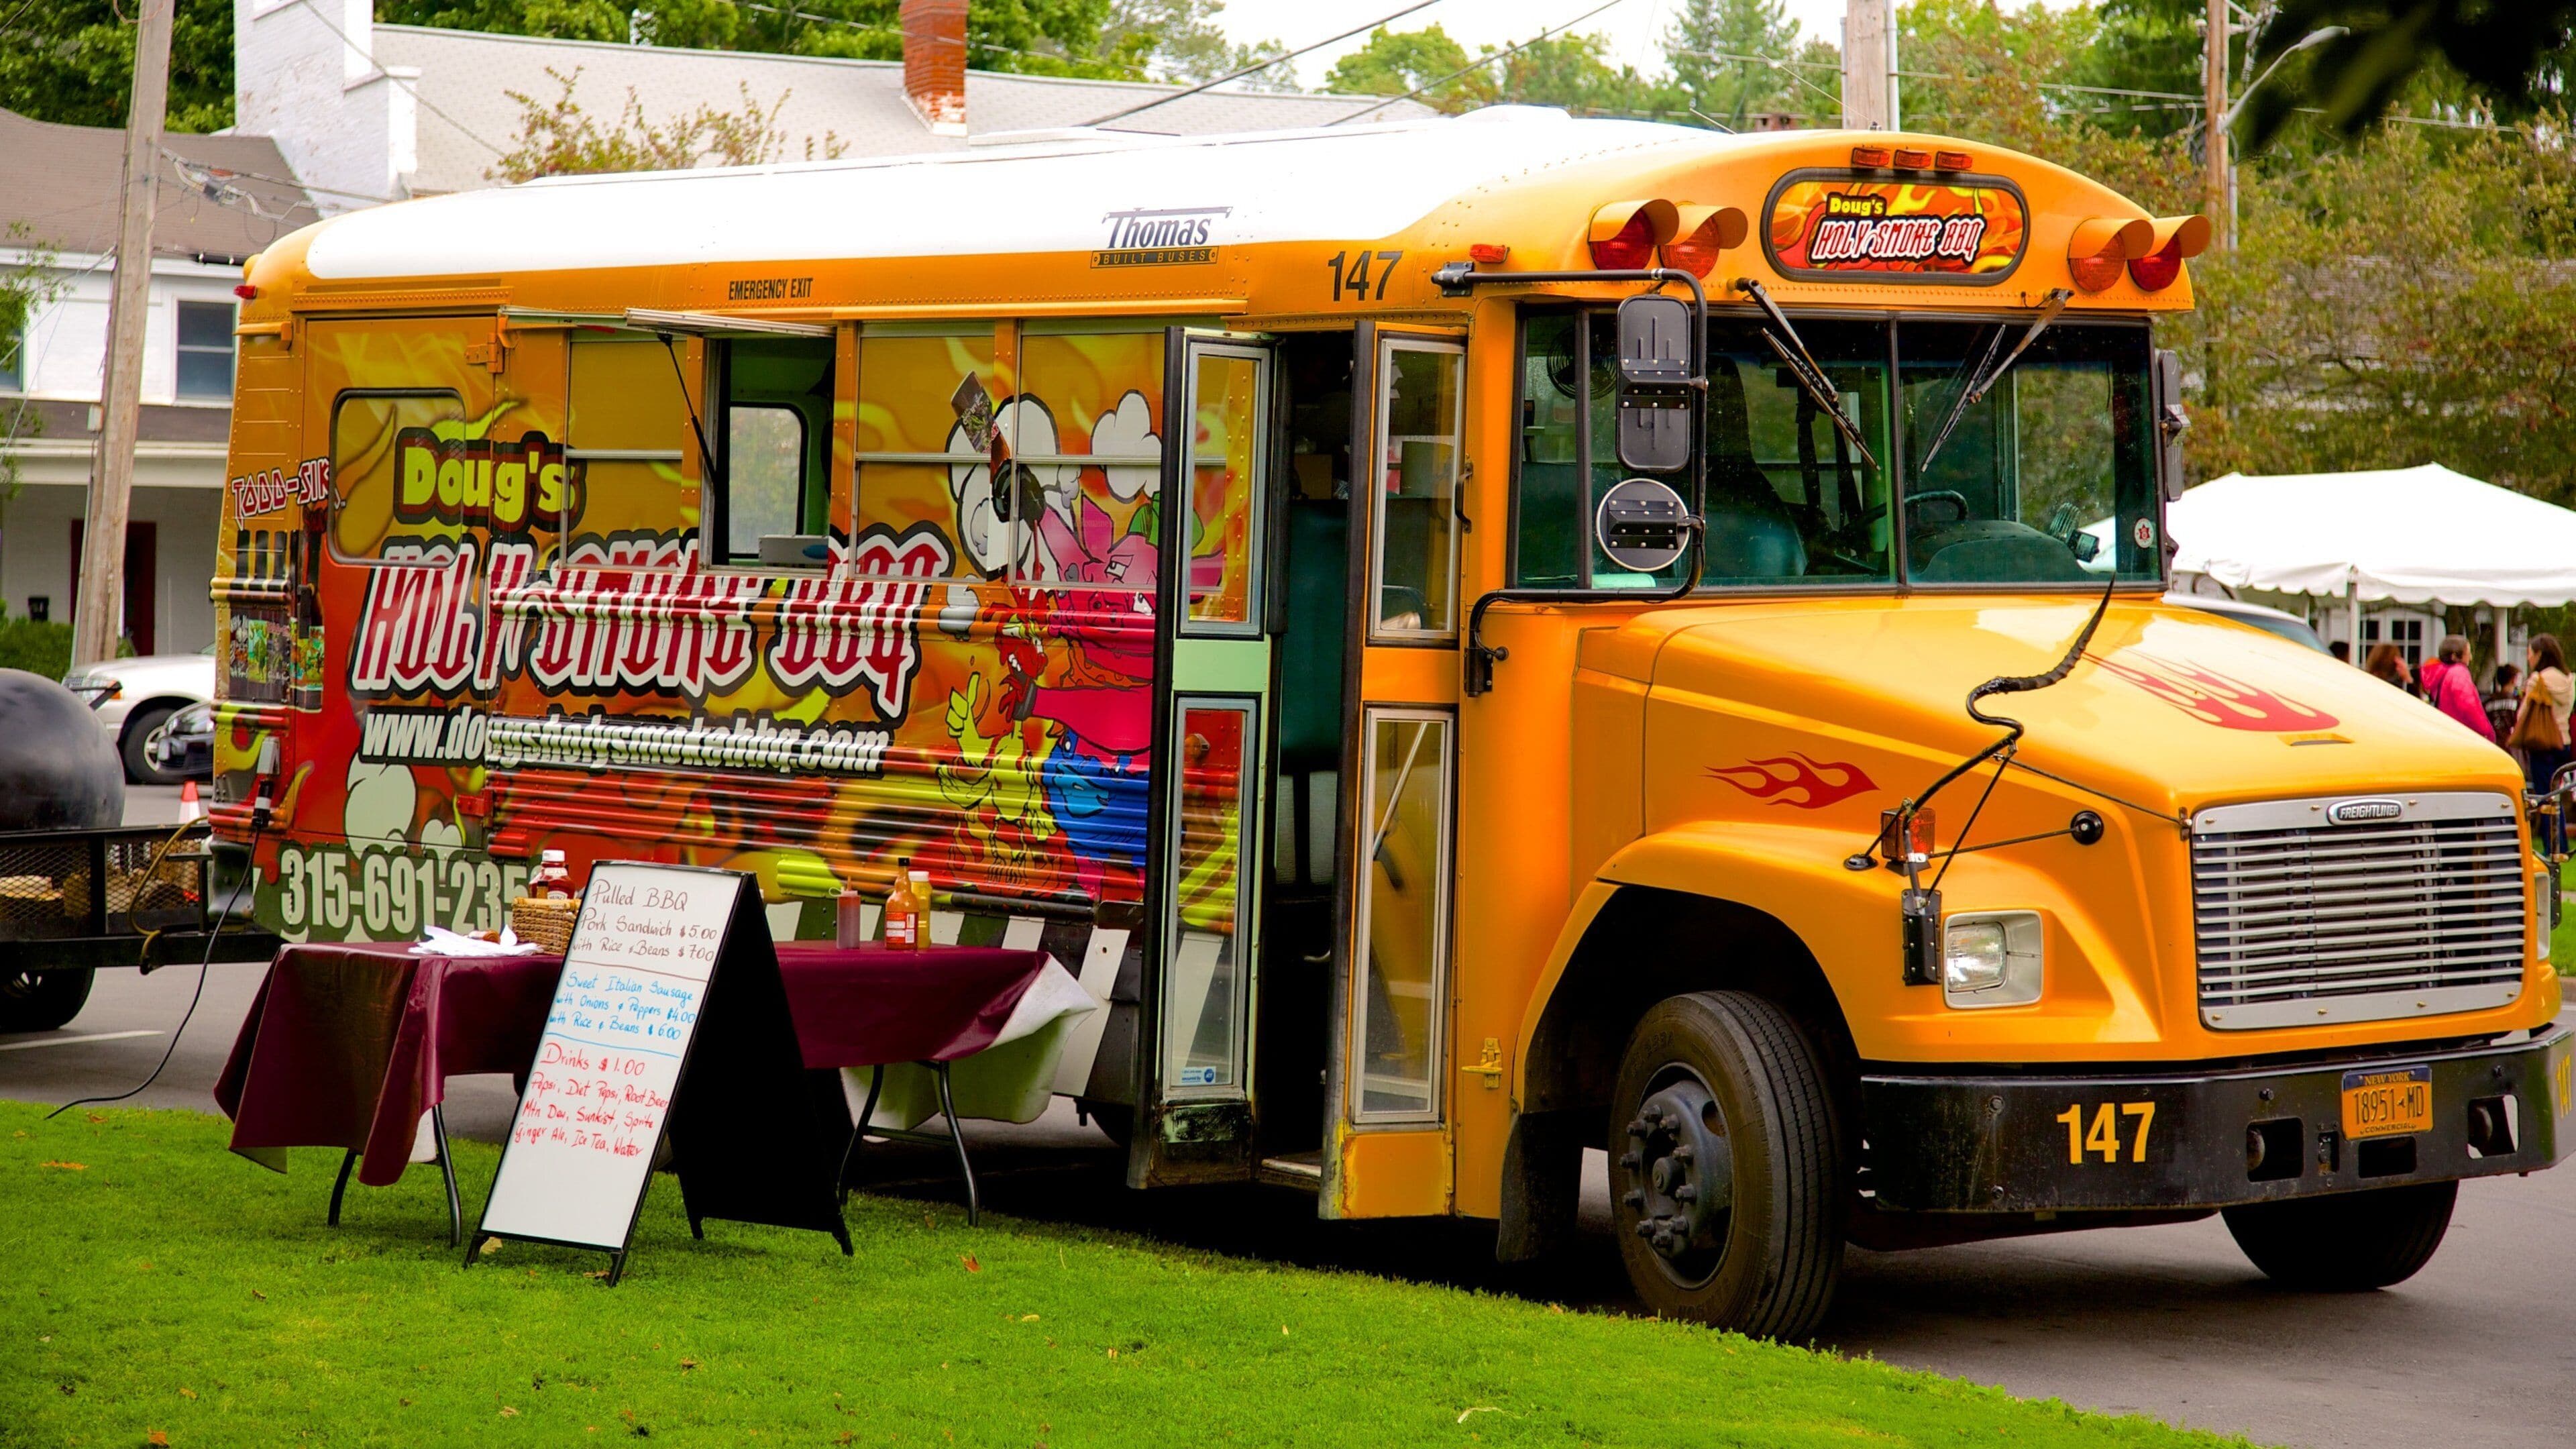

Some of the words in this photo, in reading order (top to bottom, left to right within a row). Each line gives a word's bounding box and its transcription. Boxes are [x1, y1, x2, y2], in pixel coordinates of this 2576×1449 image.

[1829, 197, 1884, 216] Doug's
[1102, 206, 1232, 248] Thomas
[1812, 220, 1873, 260] HOLY
[1868, 219, 1943, 260] SMOKE
[1937, 218, 1984, 262] BBQ
[1103, 253, 1146, 264] BUILT
[1157, 250, 1206, 262] BUSES
[729, 278, 788, 300] EMERGENCY
[790, 278, 814, 299] EXIT
[1328, 250, 1403, 301] 147
[402, 445, 576, 523] Doug's
[2339, 804, 2399, 818] FREIGHTLINER
[280, 848, 541, 935] 315-691-235
[592, 879, 635, 905] Pulled
[643, 888, 688, 912] BBQ
[580, 907, 606, 931] Pork
[616, 915, 672, 936] Sandwich
[572, 937, 592, 952] with
[600, 937, 622, 953] Rice
[566, 971, 598, 988] Sweet
[605, 975, 642, 993] Italian
[649, 981, 693, 1008] Sausage
[555, 993, 573, 1006] with
[580, 995, 609, 1010] Onions
[628, 997, 661, 1020] Peppers
[549, 1011, 566, 1025] with
[572, 1011, 592, 1028] Rice
[609, 1016, 639, 1034] Beans
[540, 1042, 589, 1070] Drinks
[566, 1079, 590, 1096] Diet
[625, 1084, 647, 1103] Root
[2365, 1073, 2386, 1085] NEW
[2387, 1072, 2411, 1083] YORK
[522, 1099, 541, 1117] Mtn
[624, 1112, 654, 1133] Sprite
[515, 1122, 547, 1145] Ginger
[572, 1130, 587, 1146] Ice
[613, 1137, 644, 1157] Water
[2056, 1101, 2155, 1165] 147
